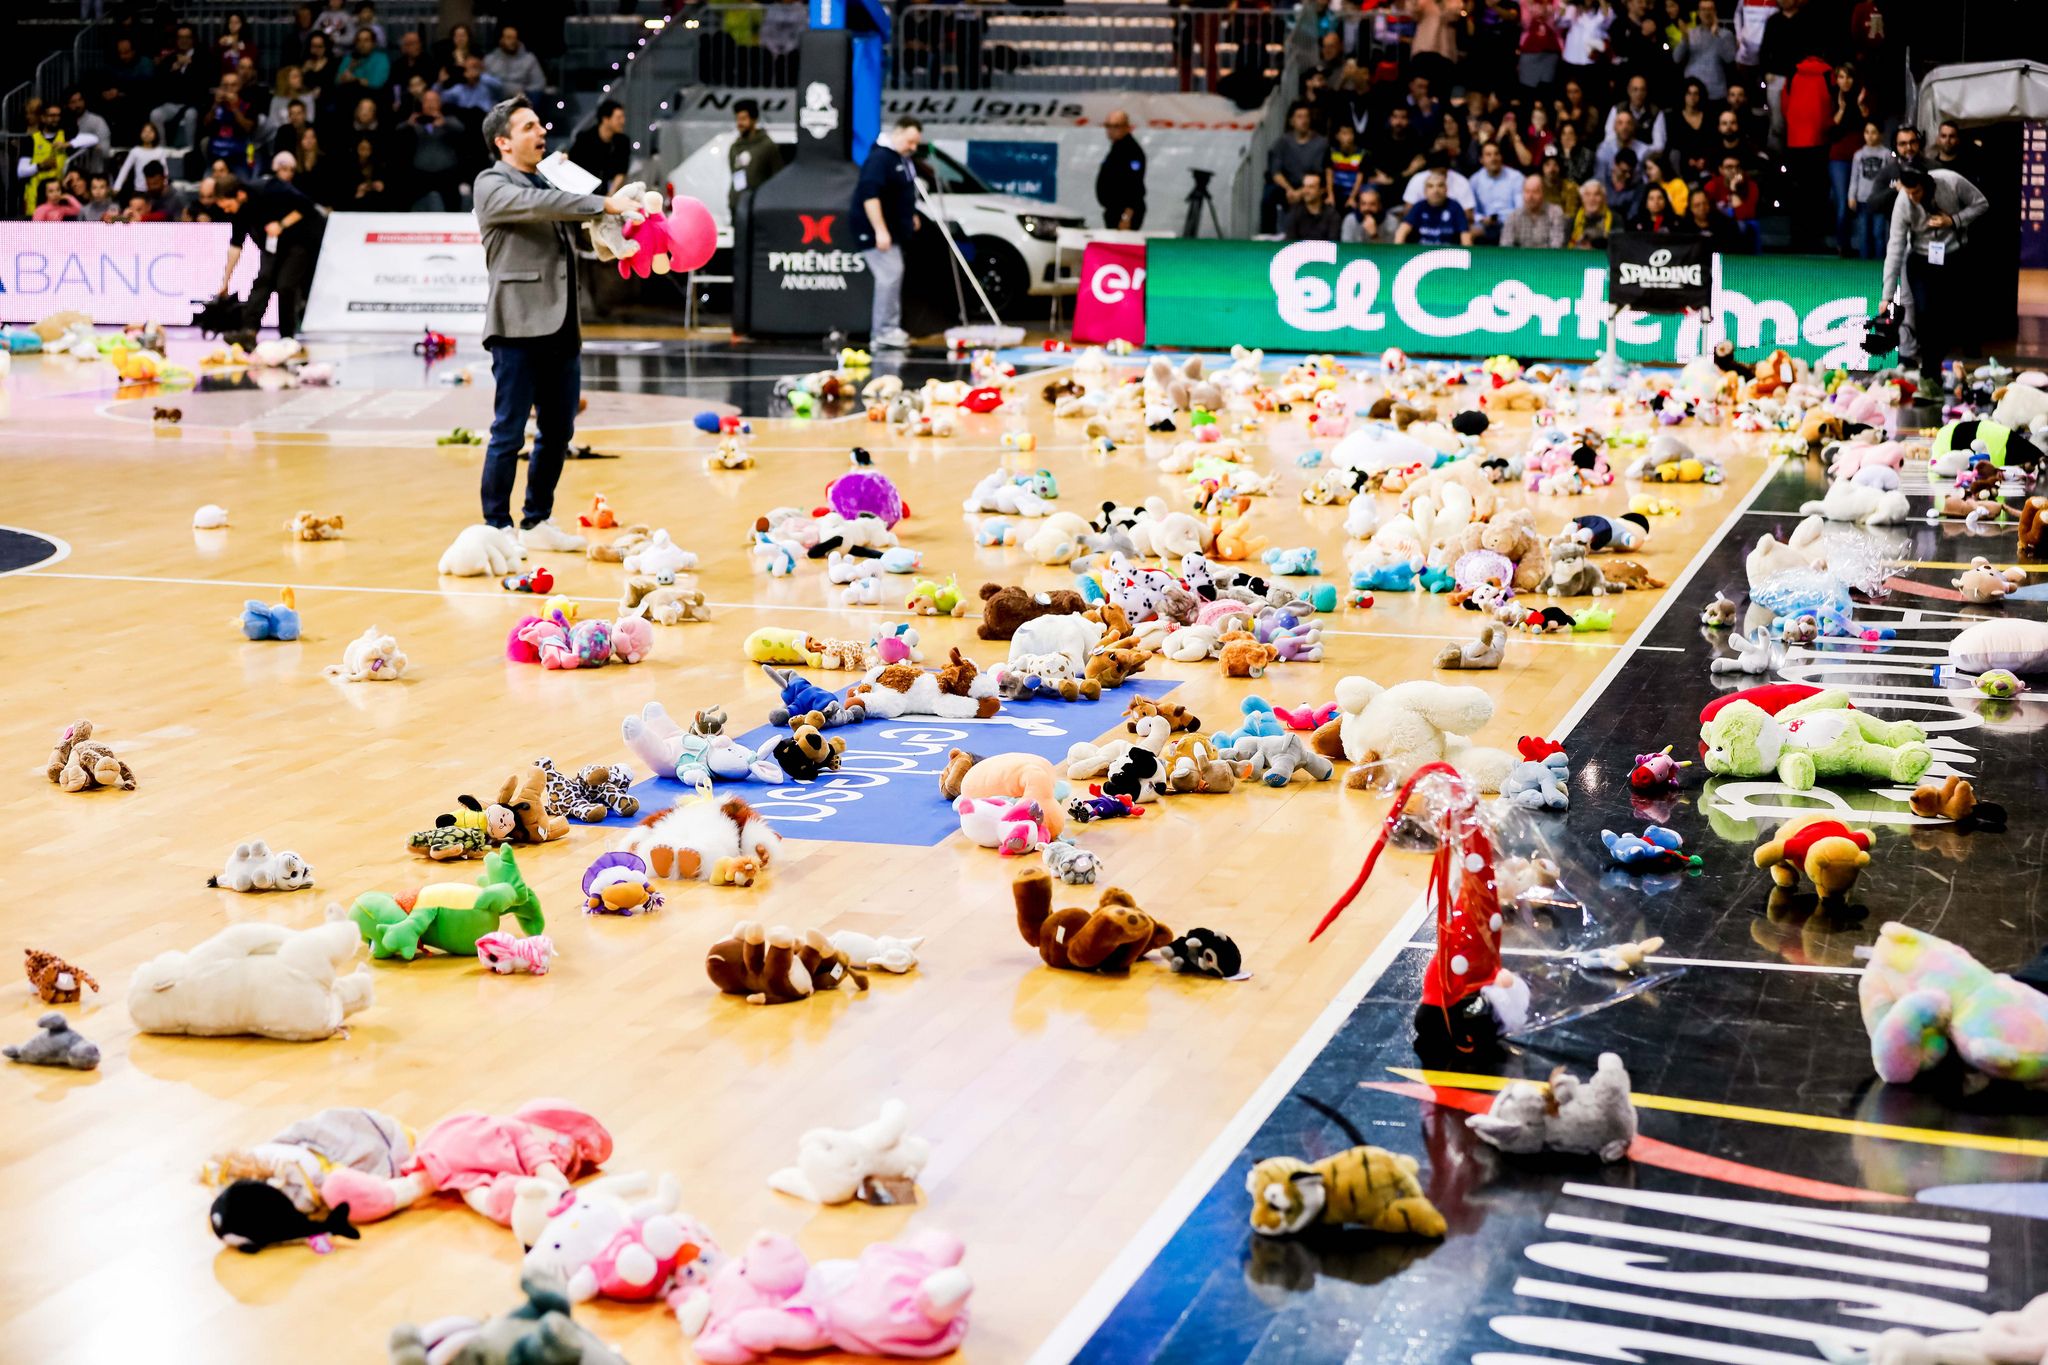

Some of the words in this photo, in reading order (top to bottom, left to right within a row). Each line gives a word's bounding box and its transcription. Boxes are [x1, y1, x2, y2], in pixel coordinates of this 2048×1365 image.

[698, 93, 787, 111] Nu
[881, 95, 958, 114] uki
[973, 96, 1084, 118] Ignis
[768, 249, 866, 273] PYRÉNÉES
[0, 251, 185, 297] BANC
[780, 274, 848, 290] ANDORRA
[1619, 262, 1702, 287] SPALDING
[1269, 240, 1386, 332] El
[1392, 248, 1662, 345] Corte
